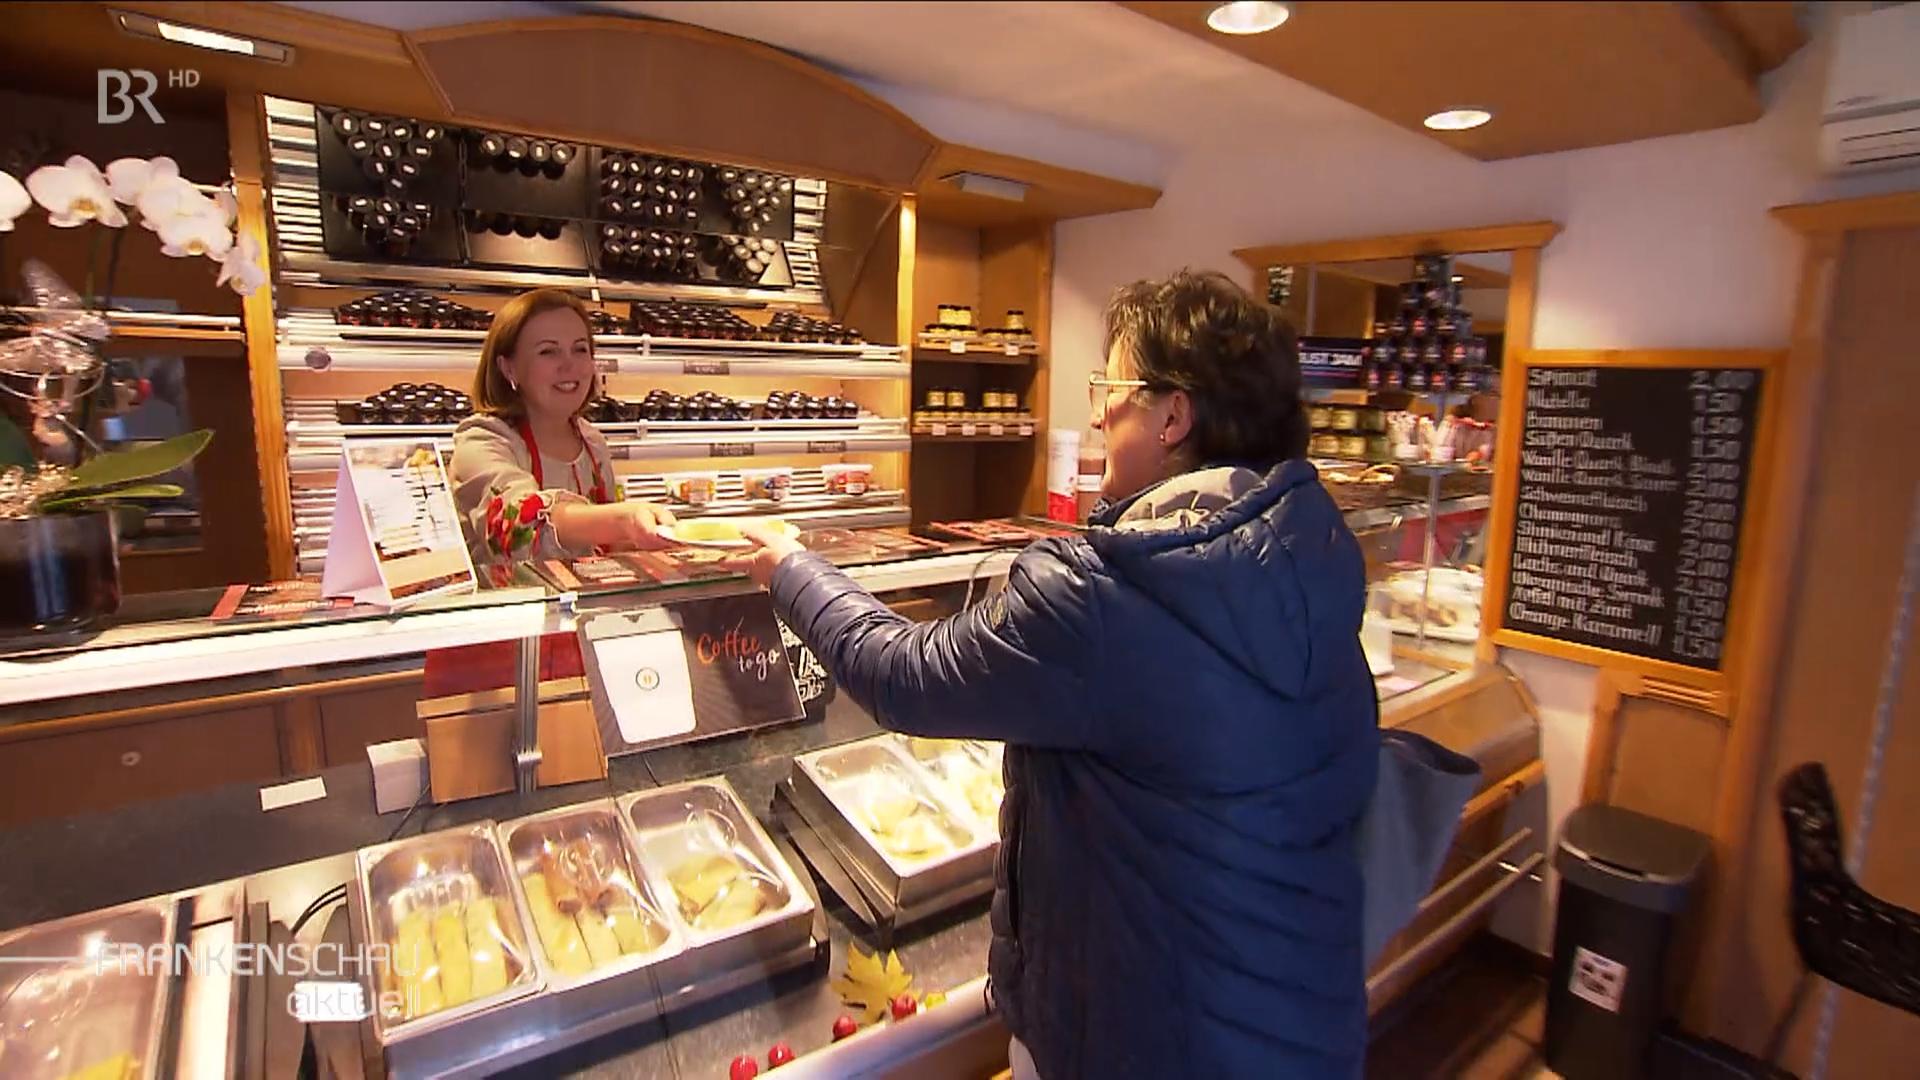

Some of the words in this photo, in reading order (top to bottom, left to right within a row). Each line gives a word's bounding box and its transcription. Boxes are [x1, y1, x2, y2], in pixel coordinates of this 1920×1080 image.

[1527, 388, 1590, 408] Nutella
[1578, 431, 1634, 450] Quark
[1521, 450, 1572, 468] Vanille
[1573, 451, 1623, 471] Quark
[1521, 469, 1572, 488] Vanille
[1512, 553, 1563, 574] Lachs
[1564, 561, 1598, 582] und
[1556, 592, 1588, 610] mit
[1590, 598, 1633, 619] Zimt
[1508, 602, 1570, 630] Orange
[1573, 612, 1662, 646] Karamell
[697, 618, 761, 664] Coffee
[740, 655, 753, 673] to
[756, 648, 780, 681] go
